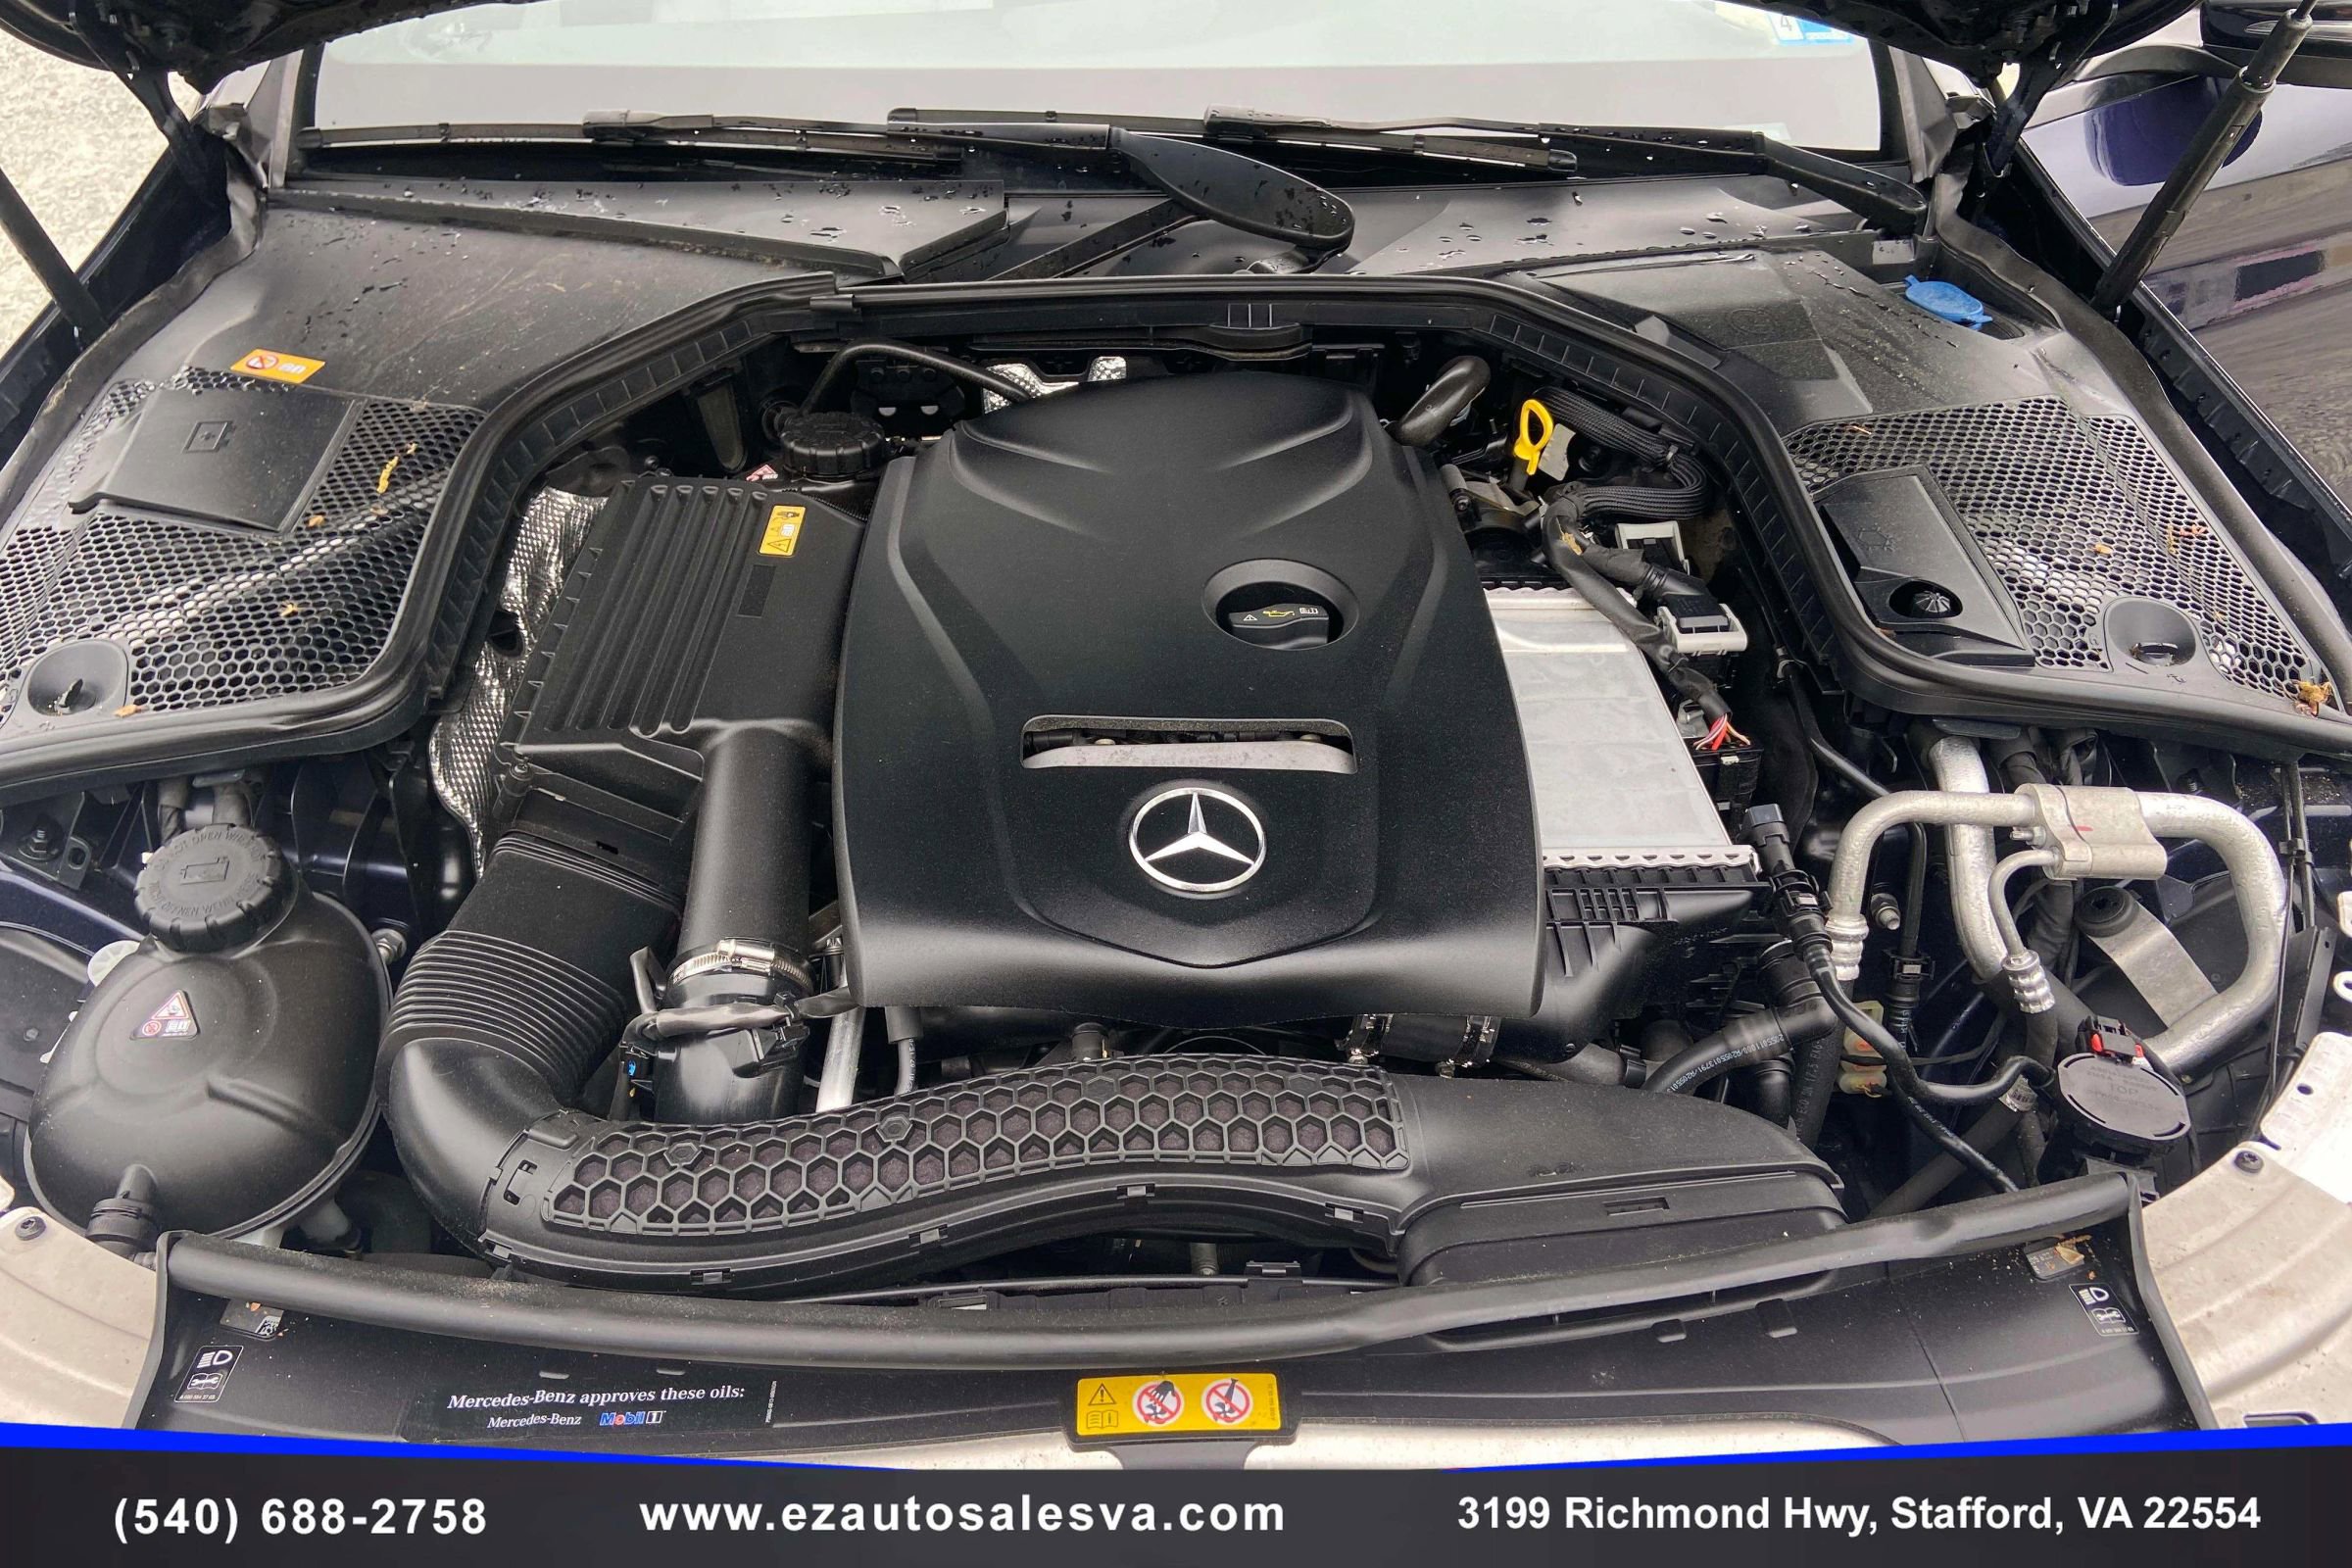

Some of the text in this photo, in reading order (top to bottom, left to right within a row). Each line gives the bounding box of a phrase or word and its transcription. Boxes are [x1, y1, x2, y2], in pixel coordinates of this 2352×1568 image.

[190, 829, 222, 846] OPEN
[447, 1384, 746, 1409] Mercedes-Benz approves these oils:
[486, 1412, 582, 1429] Mercedes-Benz
[600, 1411, 645, 1426] Mobil
